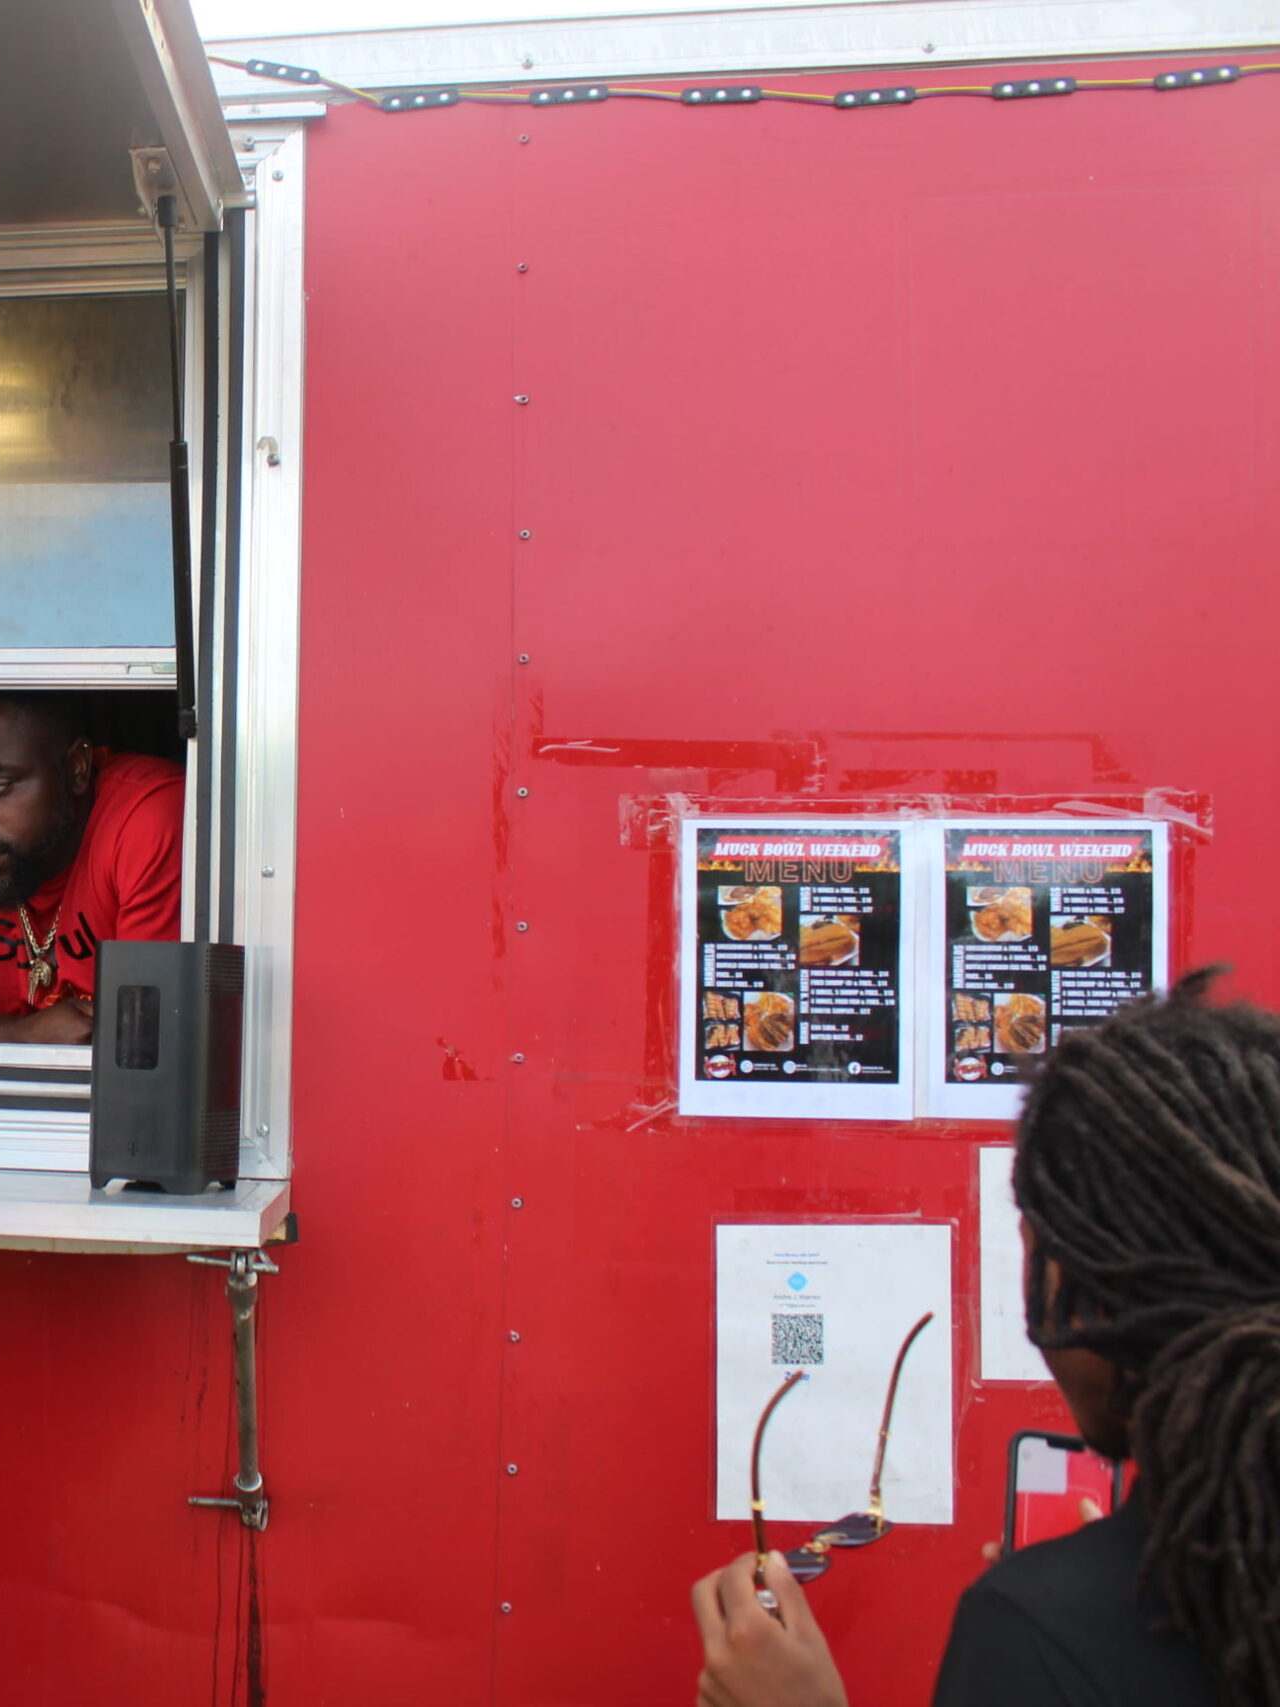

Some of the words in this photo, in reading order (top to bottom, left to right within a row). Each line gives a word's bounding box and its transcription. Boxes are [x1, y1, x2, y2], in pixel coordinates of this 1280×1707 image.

[714, 842, 760, 856] MUCK
[761, 843, 805, 856] BOWL
[810, 843, 881, 857] WEEKEND
[962, 843, 1010, 857] MUCK
[1010, 843, 1055, 857] BOWL
[1059, 843, 1132, 857] WEEKEND
[744, 857, 852, 883] MENU
[994, 857, 1104, 884] MENU
